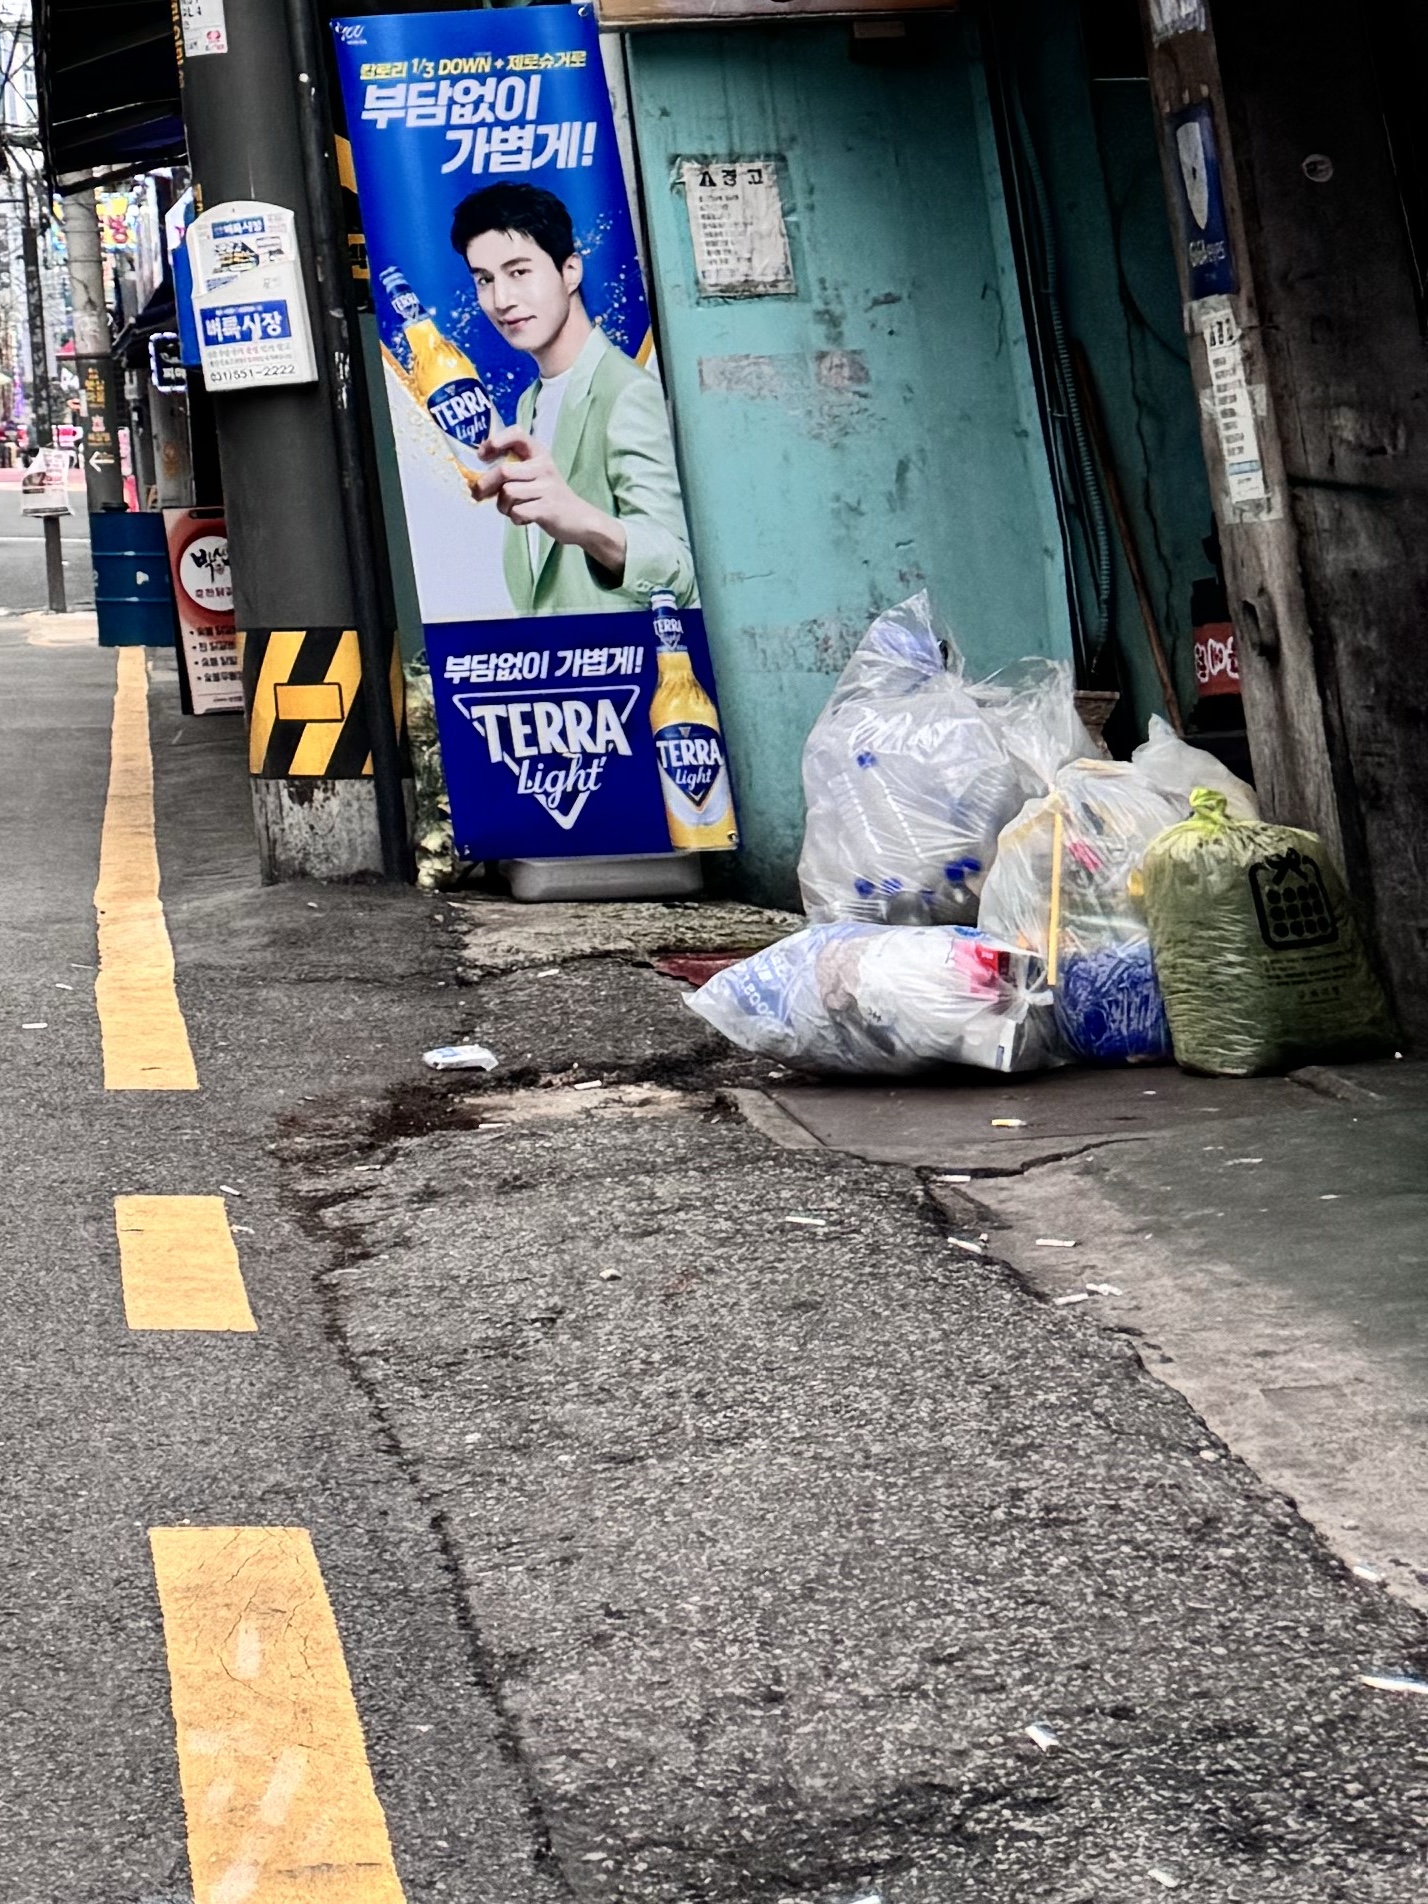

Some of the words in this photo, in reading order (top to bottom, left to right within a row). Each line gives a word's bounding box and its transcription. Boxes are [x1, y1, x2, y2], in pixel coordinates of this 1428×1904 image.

[360, 59, 407, 81] 칼로리
[411, 58, 435, 79] 1/3
[438, 54, 491, 76] DOWN
[360, 74, 541, 130] 부담없이
[441, 121, 597, 175] 가볍게!
[205, 312, 283, 342] 벼룩시장
[430, 385, 492, 433] TERRA
[444, 648, 549, 683] 부담없이
[555, 645, 644, 680] 가볍게!
[470, 698, 633, 764] TERRA
[656, 736, 723, 767] TERRA
[516, 752, 607, 807] Light
[674, 764, 713, 788] Light
